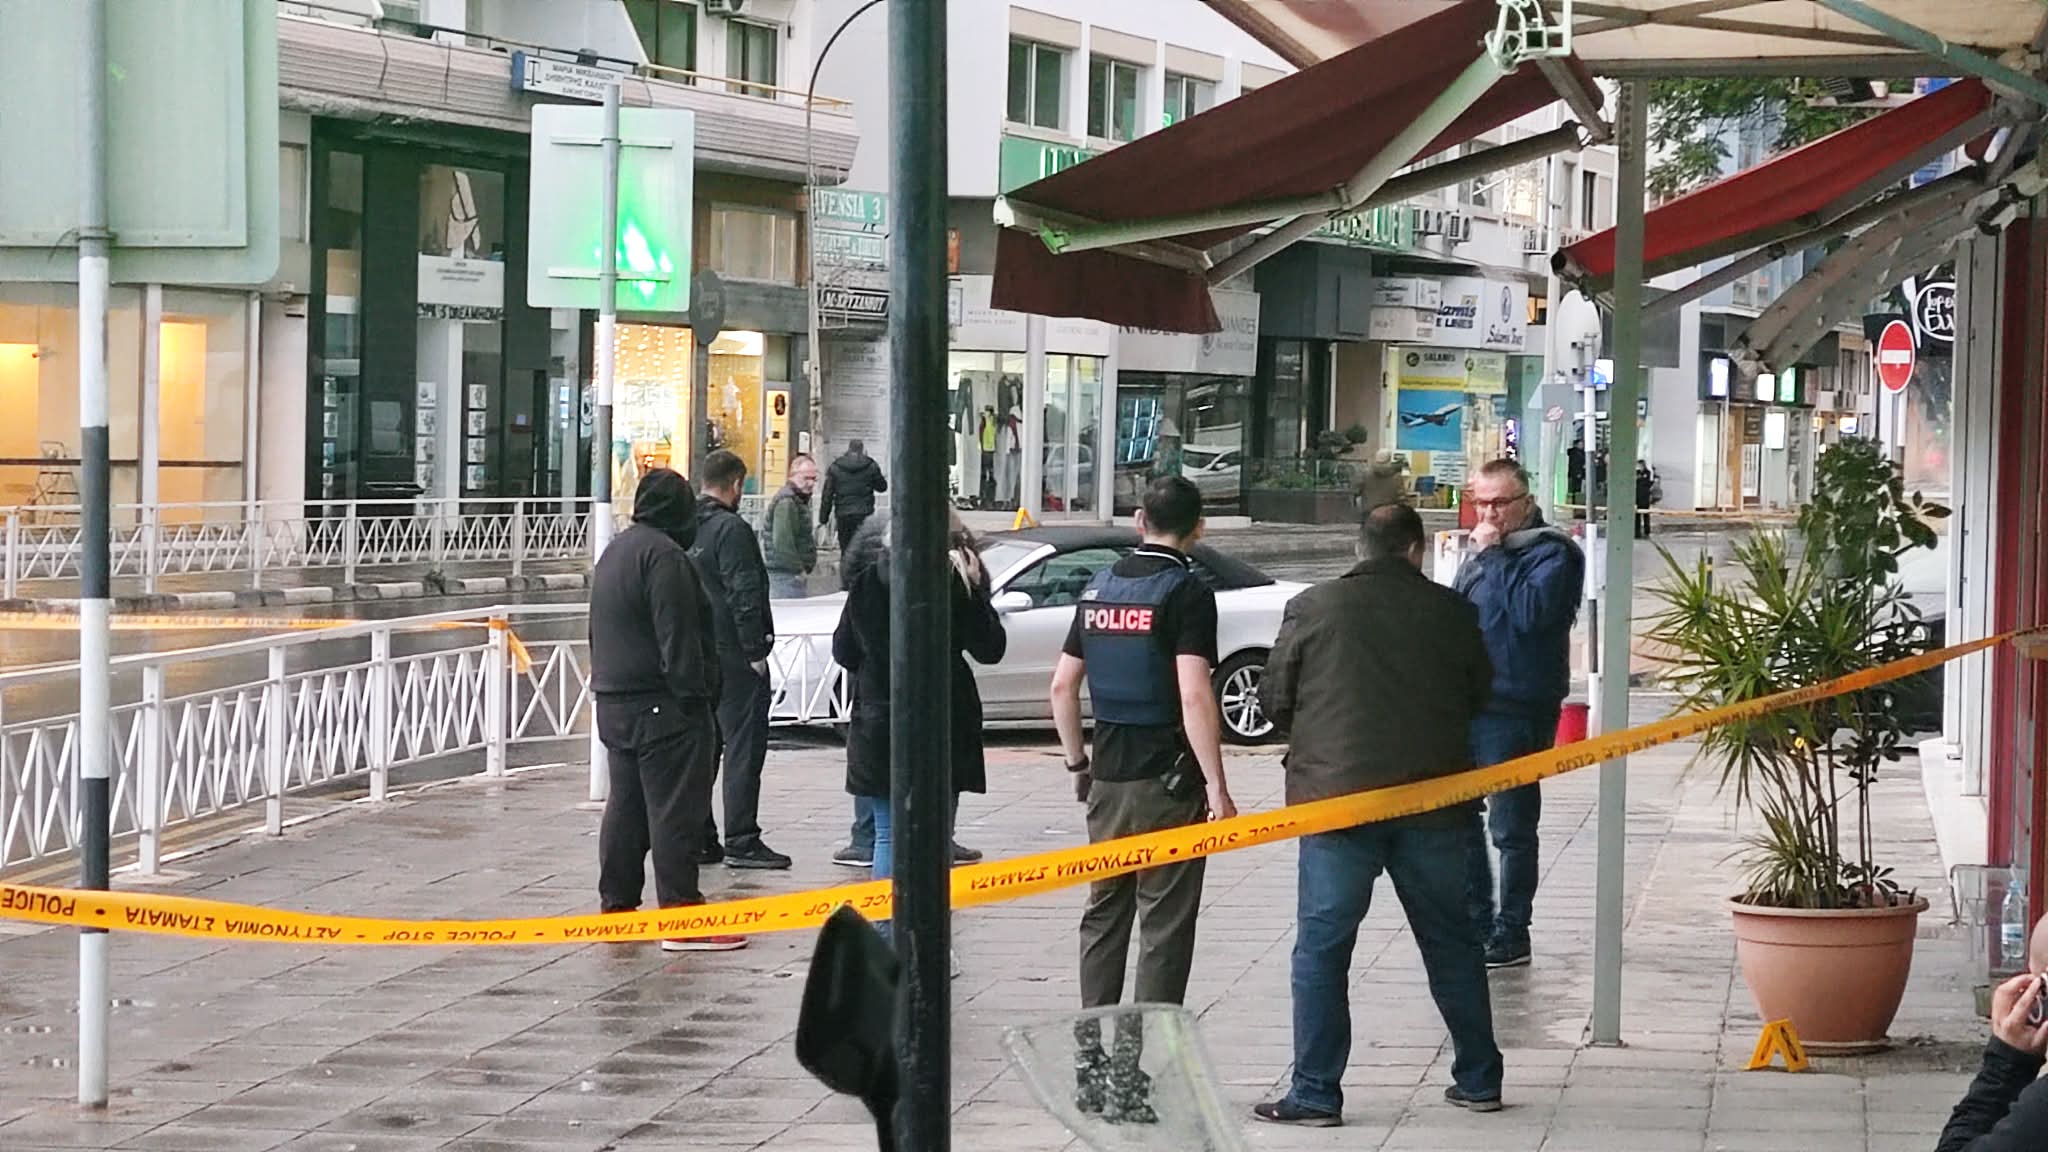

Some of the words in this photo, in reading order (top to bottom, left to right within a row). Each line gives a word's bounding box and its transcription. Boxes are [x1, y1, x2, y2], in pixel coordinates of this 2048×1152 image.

[871, 197, 881, 220] 3
[1445, 317, 1474, 329] LINES
[1083, 608, 1154, 631] POLICE
[1056, 845, 1158, 876] ΑΣΤΥΝΟΜΙΑ
[971, 866, 1049, 889] ΣΤΑΜΑΤΑ
[1, 888, 75, 916] POLICE
[125, 906, 215, 932] ΣΤΑΜΑΤΑ
[224, 919, 341, 939] ΑΣΤΥΝΟΜΙΑ
[563, 921, 649, 939] ΣΤΑΜΑΤΑ
[658, 910, 766, 935] ΑΣΤΥΝΟΜΙΑ
[383, 930, 435, 941] STOP
[447, 930, 516, 941] POLICE
